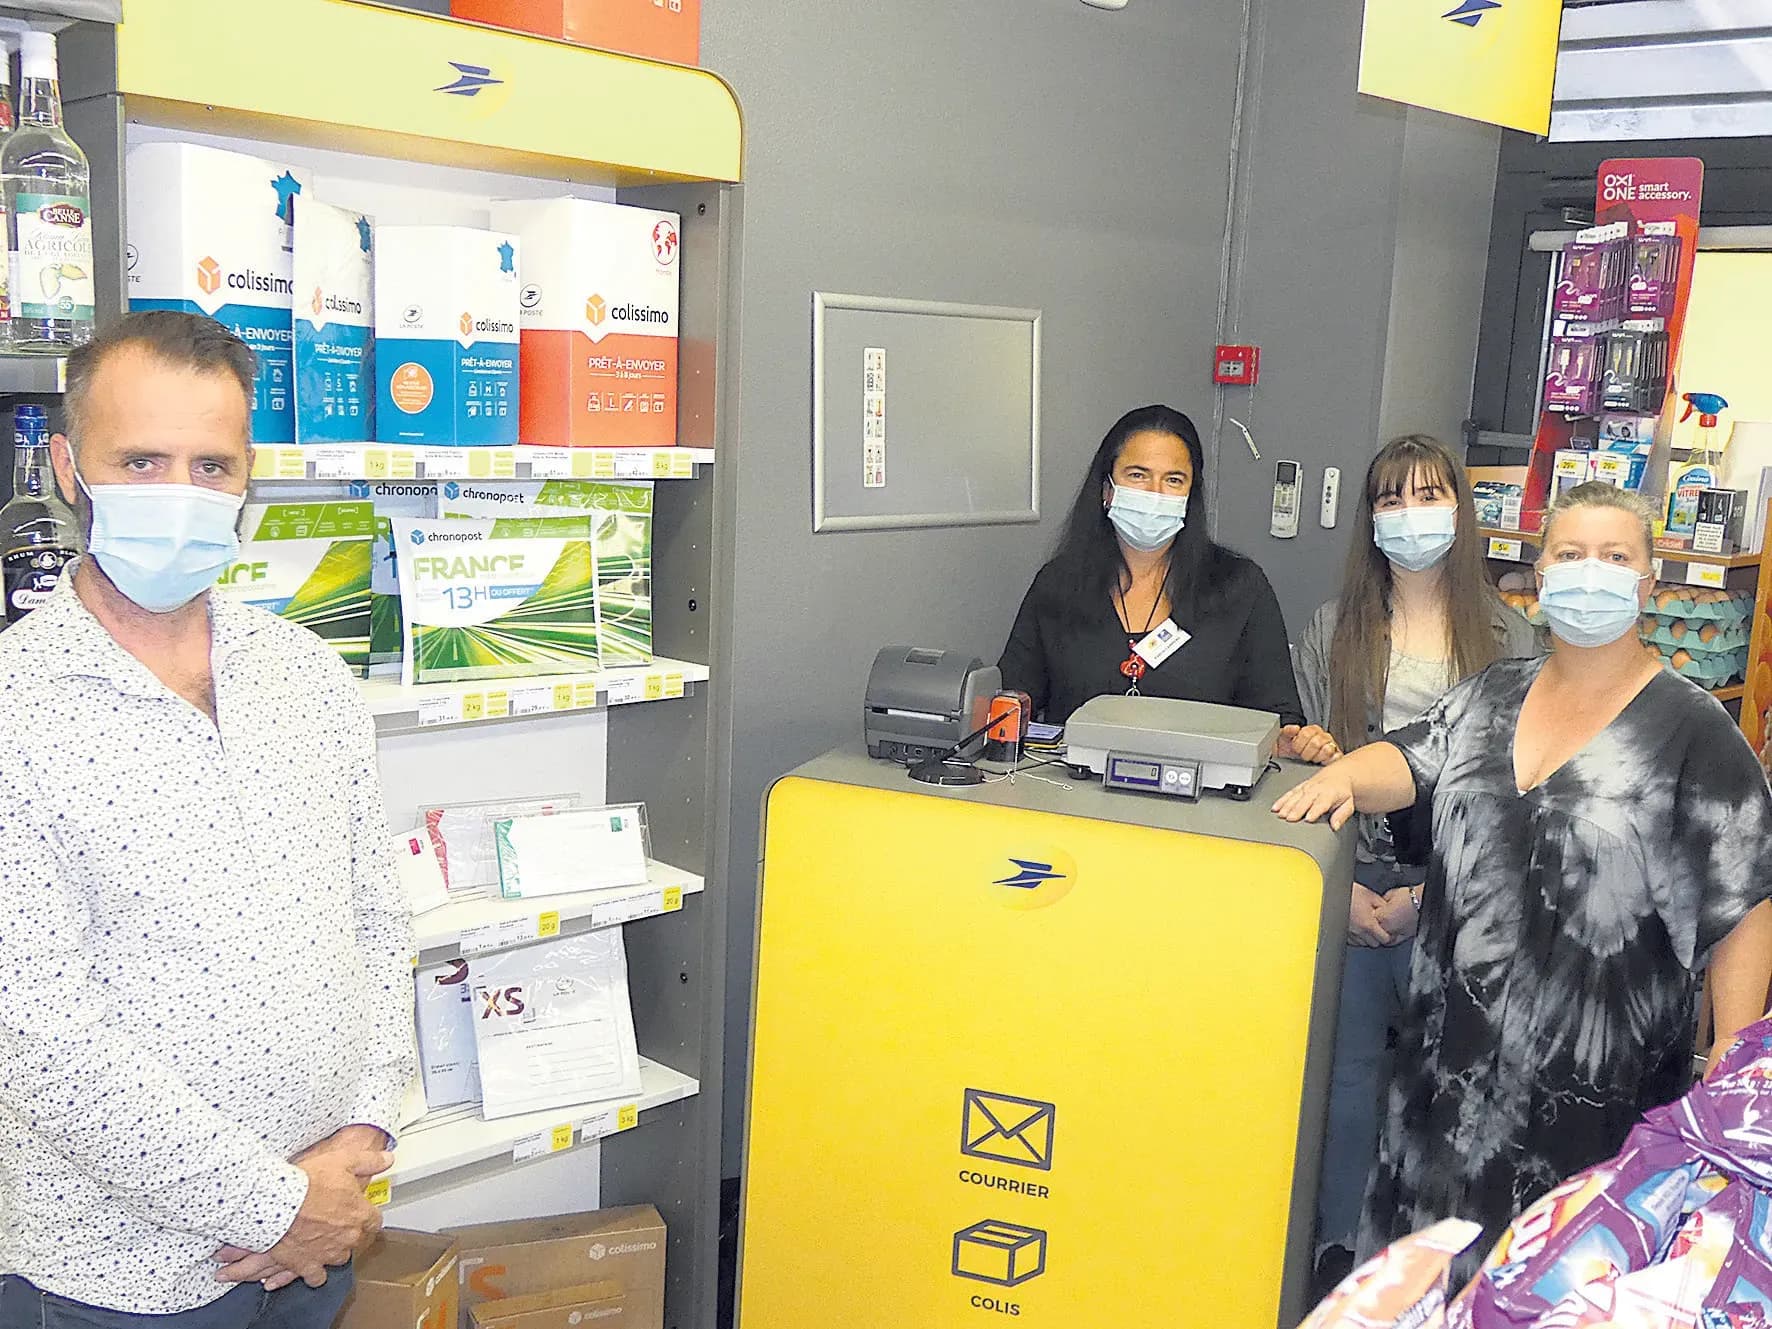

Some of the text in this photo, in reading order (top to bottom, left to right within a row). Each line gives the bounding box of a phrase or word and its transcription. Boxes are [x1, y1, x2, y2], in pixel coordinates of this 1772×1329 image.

[1604, 174, 1633, 187] OXI
[1639, 182, 1669, 191] smart
[1604, 187, 1636, 200] ONE
[1638, 191, 1692, 201] accessory.
[43, 209, 81, 224] CANNE
[611, 303, 669, 324] colissimo
[476, 317, 514, 333] colissimo
[588, 355, 666, 371] PRÊT-À-ENVOYER
[463, 487, 525, 504] chronopost
[428, 531, 483, 542] chronopost
[413, 554, 525, 580] FRANCE
[481, 986, 525, 1020] XS
[959, 1170, 1050, 1200] COURRIER
[608, 1241, 657, 1256] colissimo
[970, 1295, 1021, 1317] COLIS
